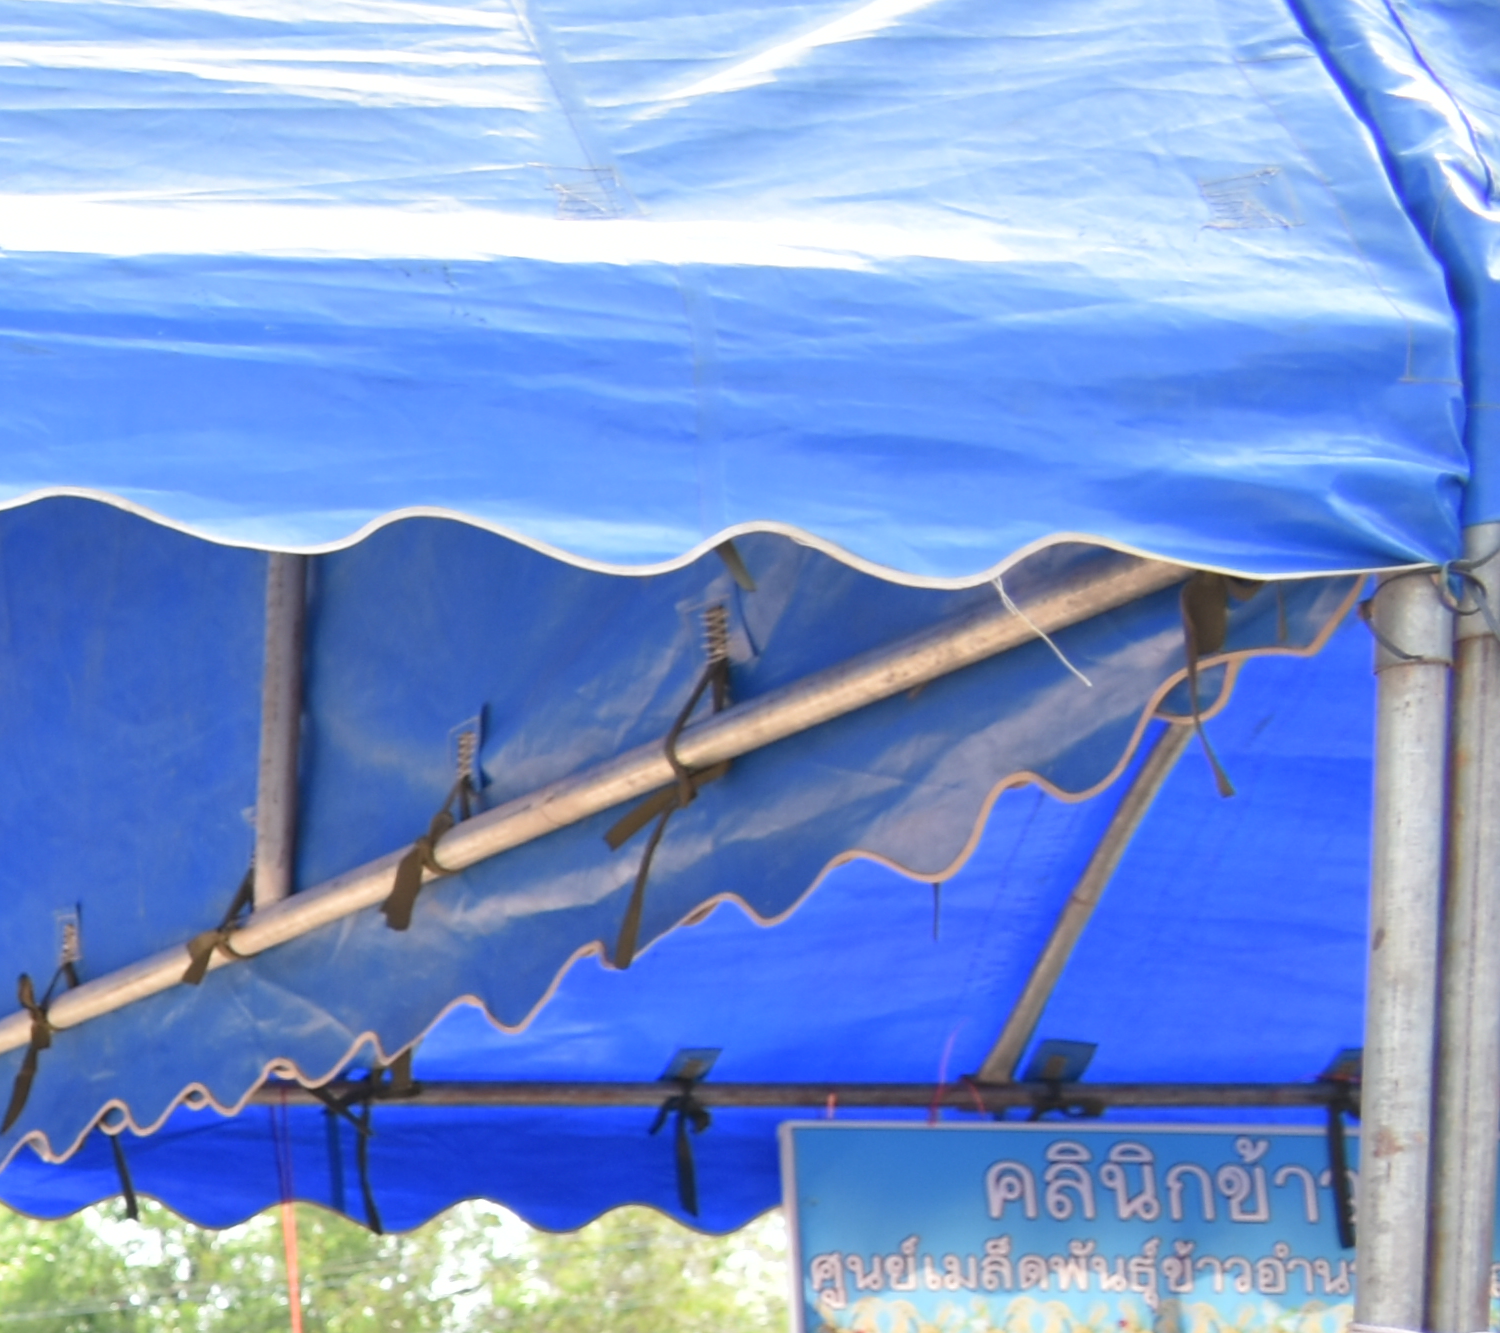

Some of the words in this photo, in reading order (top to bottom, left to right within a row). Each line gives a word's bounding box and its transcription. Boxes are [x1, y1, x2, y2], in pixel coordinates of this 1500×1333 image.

[808, 1235, 1356, 1308] ศูนย์เมล็ดพันธุ์ข้าวอำน
